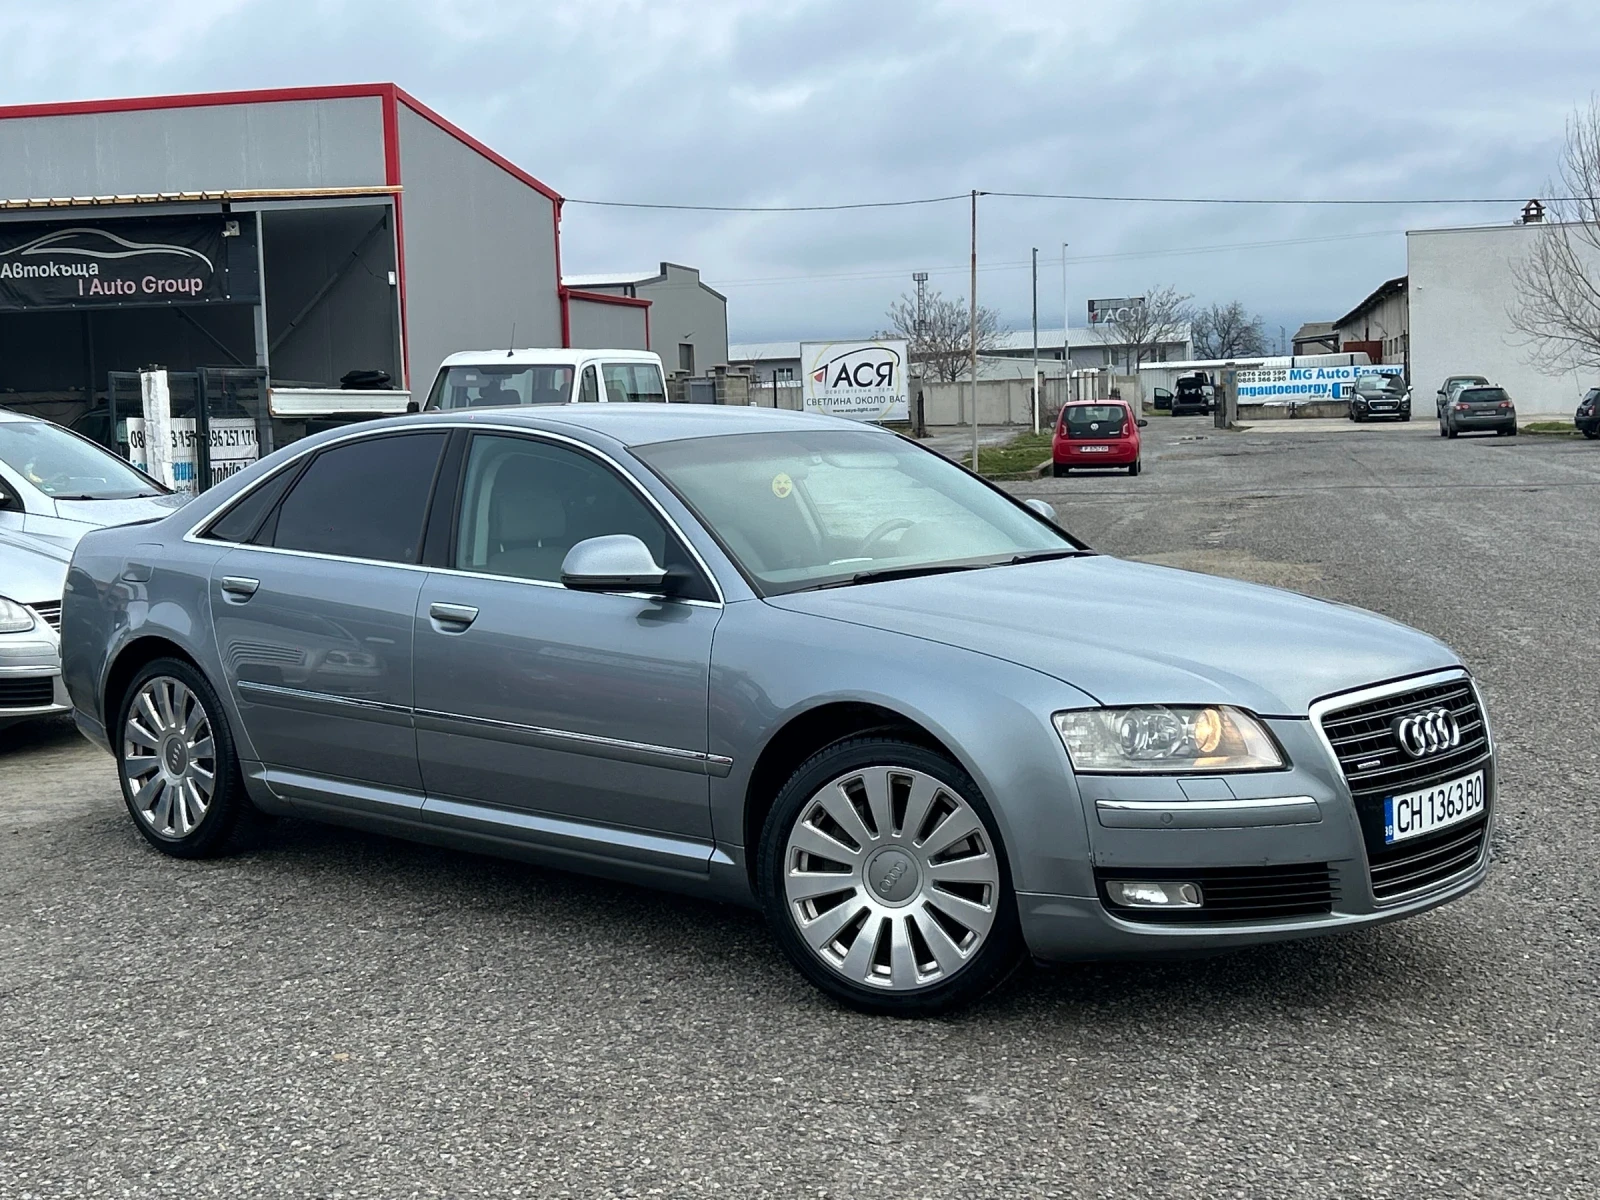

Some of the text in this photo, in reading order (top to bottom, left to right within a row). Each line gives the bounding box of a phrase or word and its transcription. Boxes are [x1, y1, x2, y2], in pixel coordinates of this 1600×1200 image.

[0, 261, 99, 279] Автокъща
[90, 278, 136, 295] Auto
[141, 275, 203, 296] Group
[832, 361, 894, 388] АСЯ
[1289, 369, 1313, 381] MG
[1316, 367, 1350, 380] Auto
[806, 394, 906, 406] СВЕТЛИНА ОКОЛО ВАС
[1427, 782, 1464, 826] 1363
